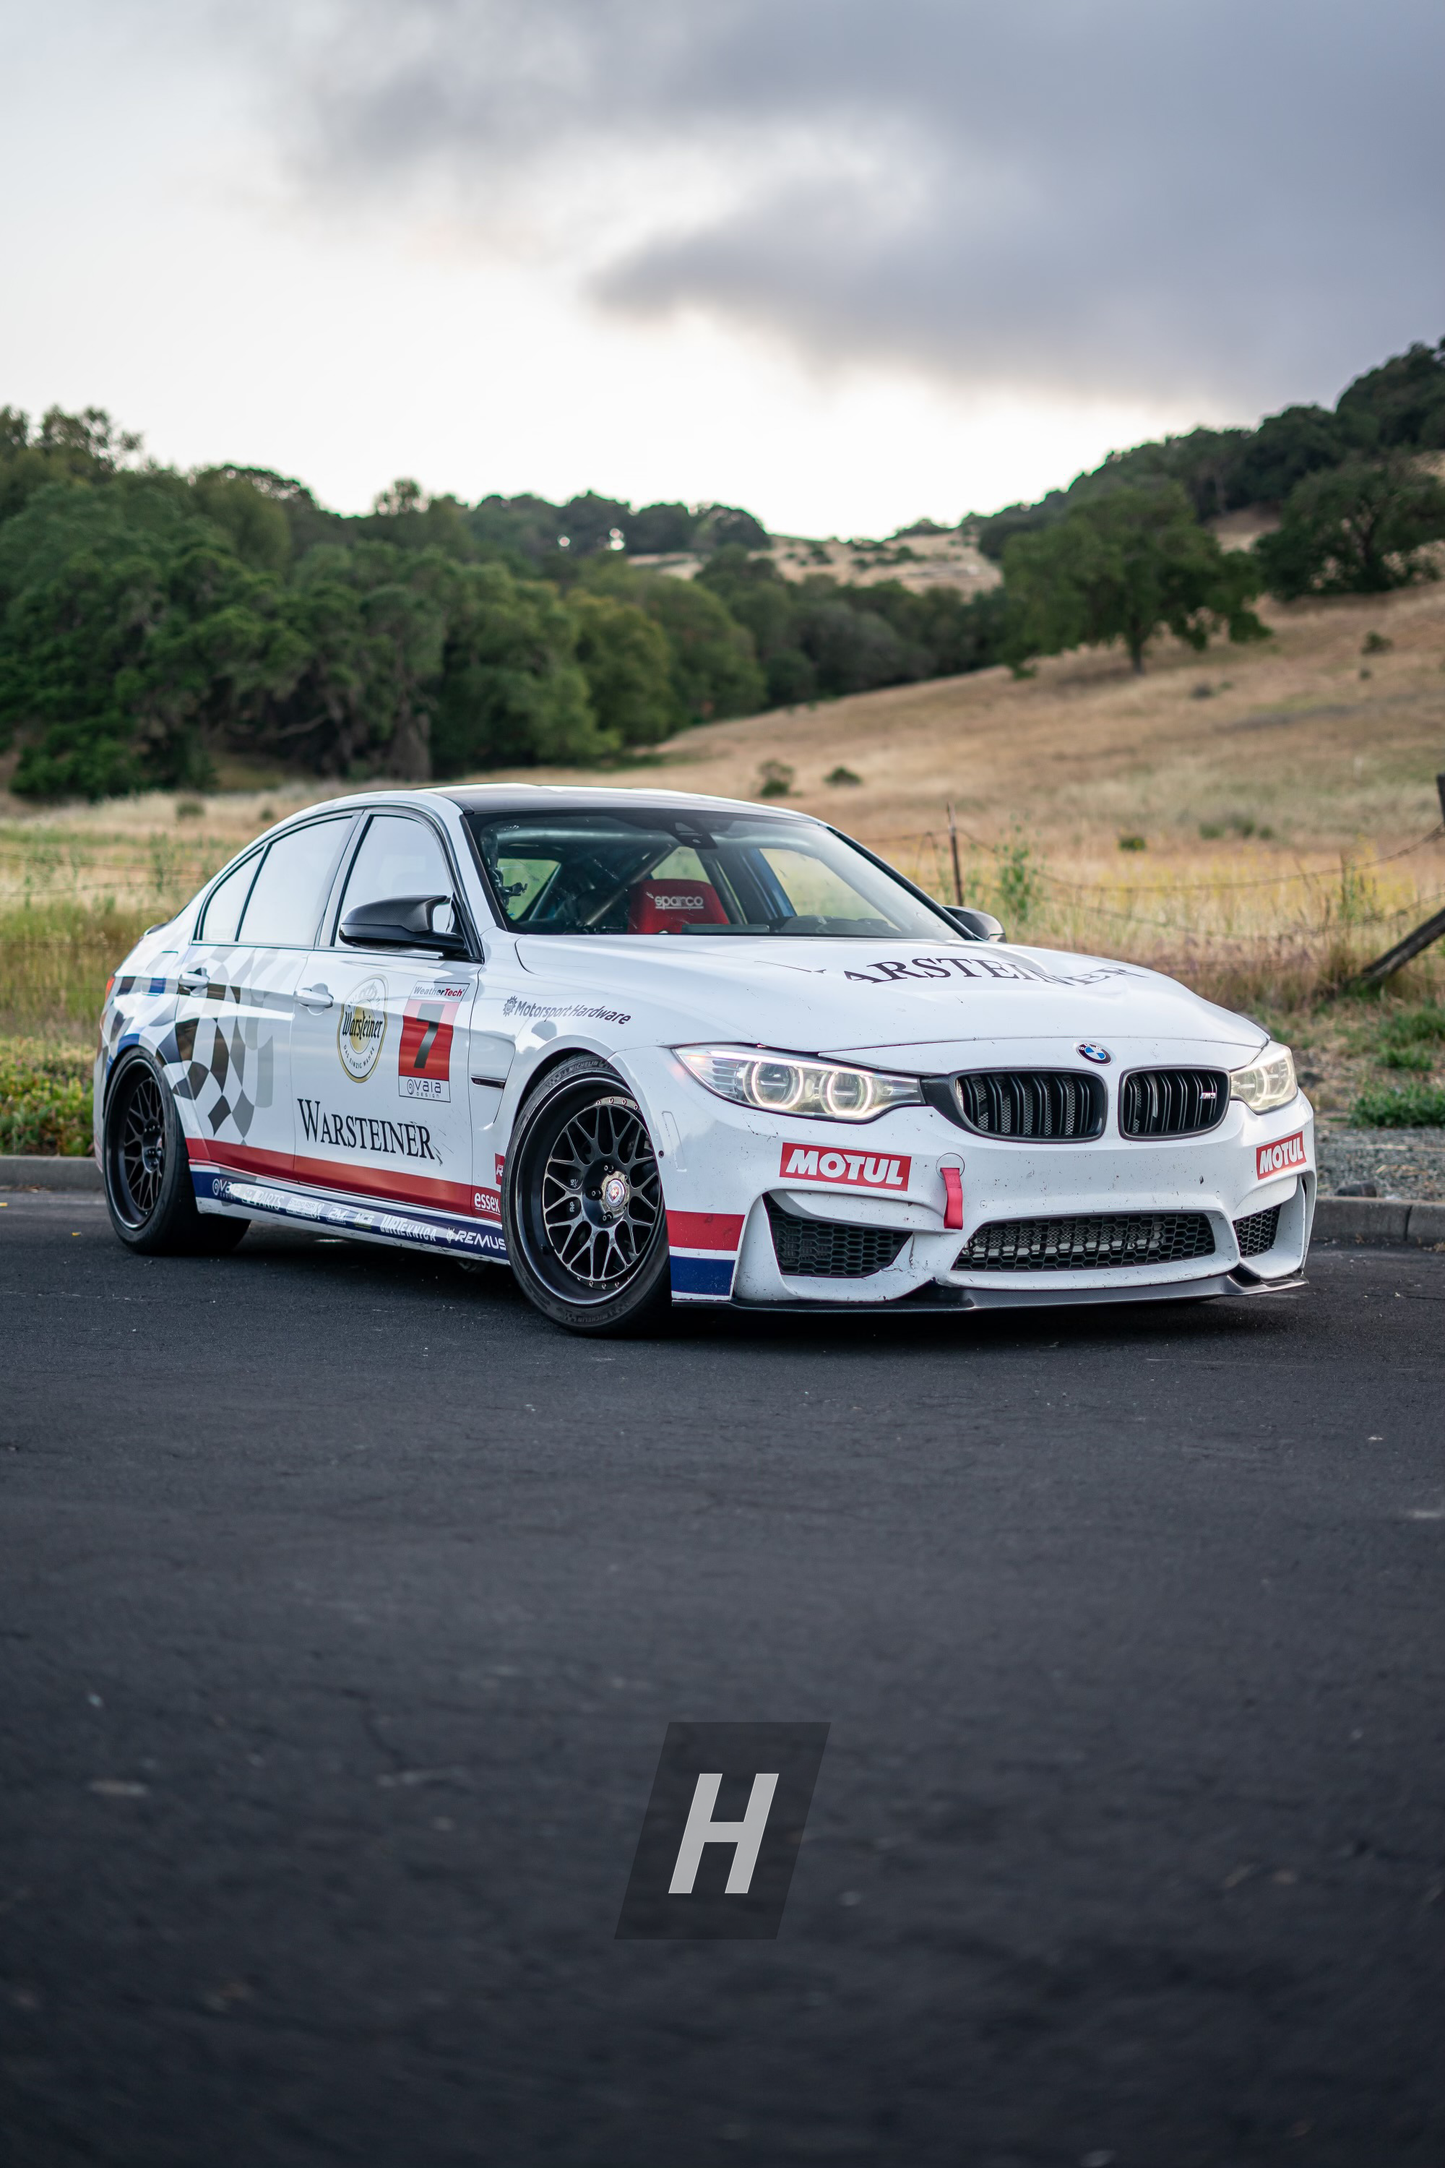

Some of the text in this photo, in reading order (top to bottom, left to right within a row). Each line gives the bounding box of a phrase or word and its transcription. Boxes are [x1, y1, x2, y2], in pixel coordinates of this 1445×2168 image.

[654, 895, 704, 910] sparco
[817, 957, 1150, 987] ARSTEINER
[413, 986, 464, 998] WeatherTech
[342, 1011, 384, 1041] Warsteiner
[413, 1003, 446, 1069] 7
[567, 1060, 598, 1072] MICHELIN
[785, 1149, 904, 1186] MOTUL
[1258, 1141, 1304, 1175] MOTUL
[474, 1192, 501, 1213] essex
[455, 1230, 507, 1251] REMUS
